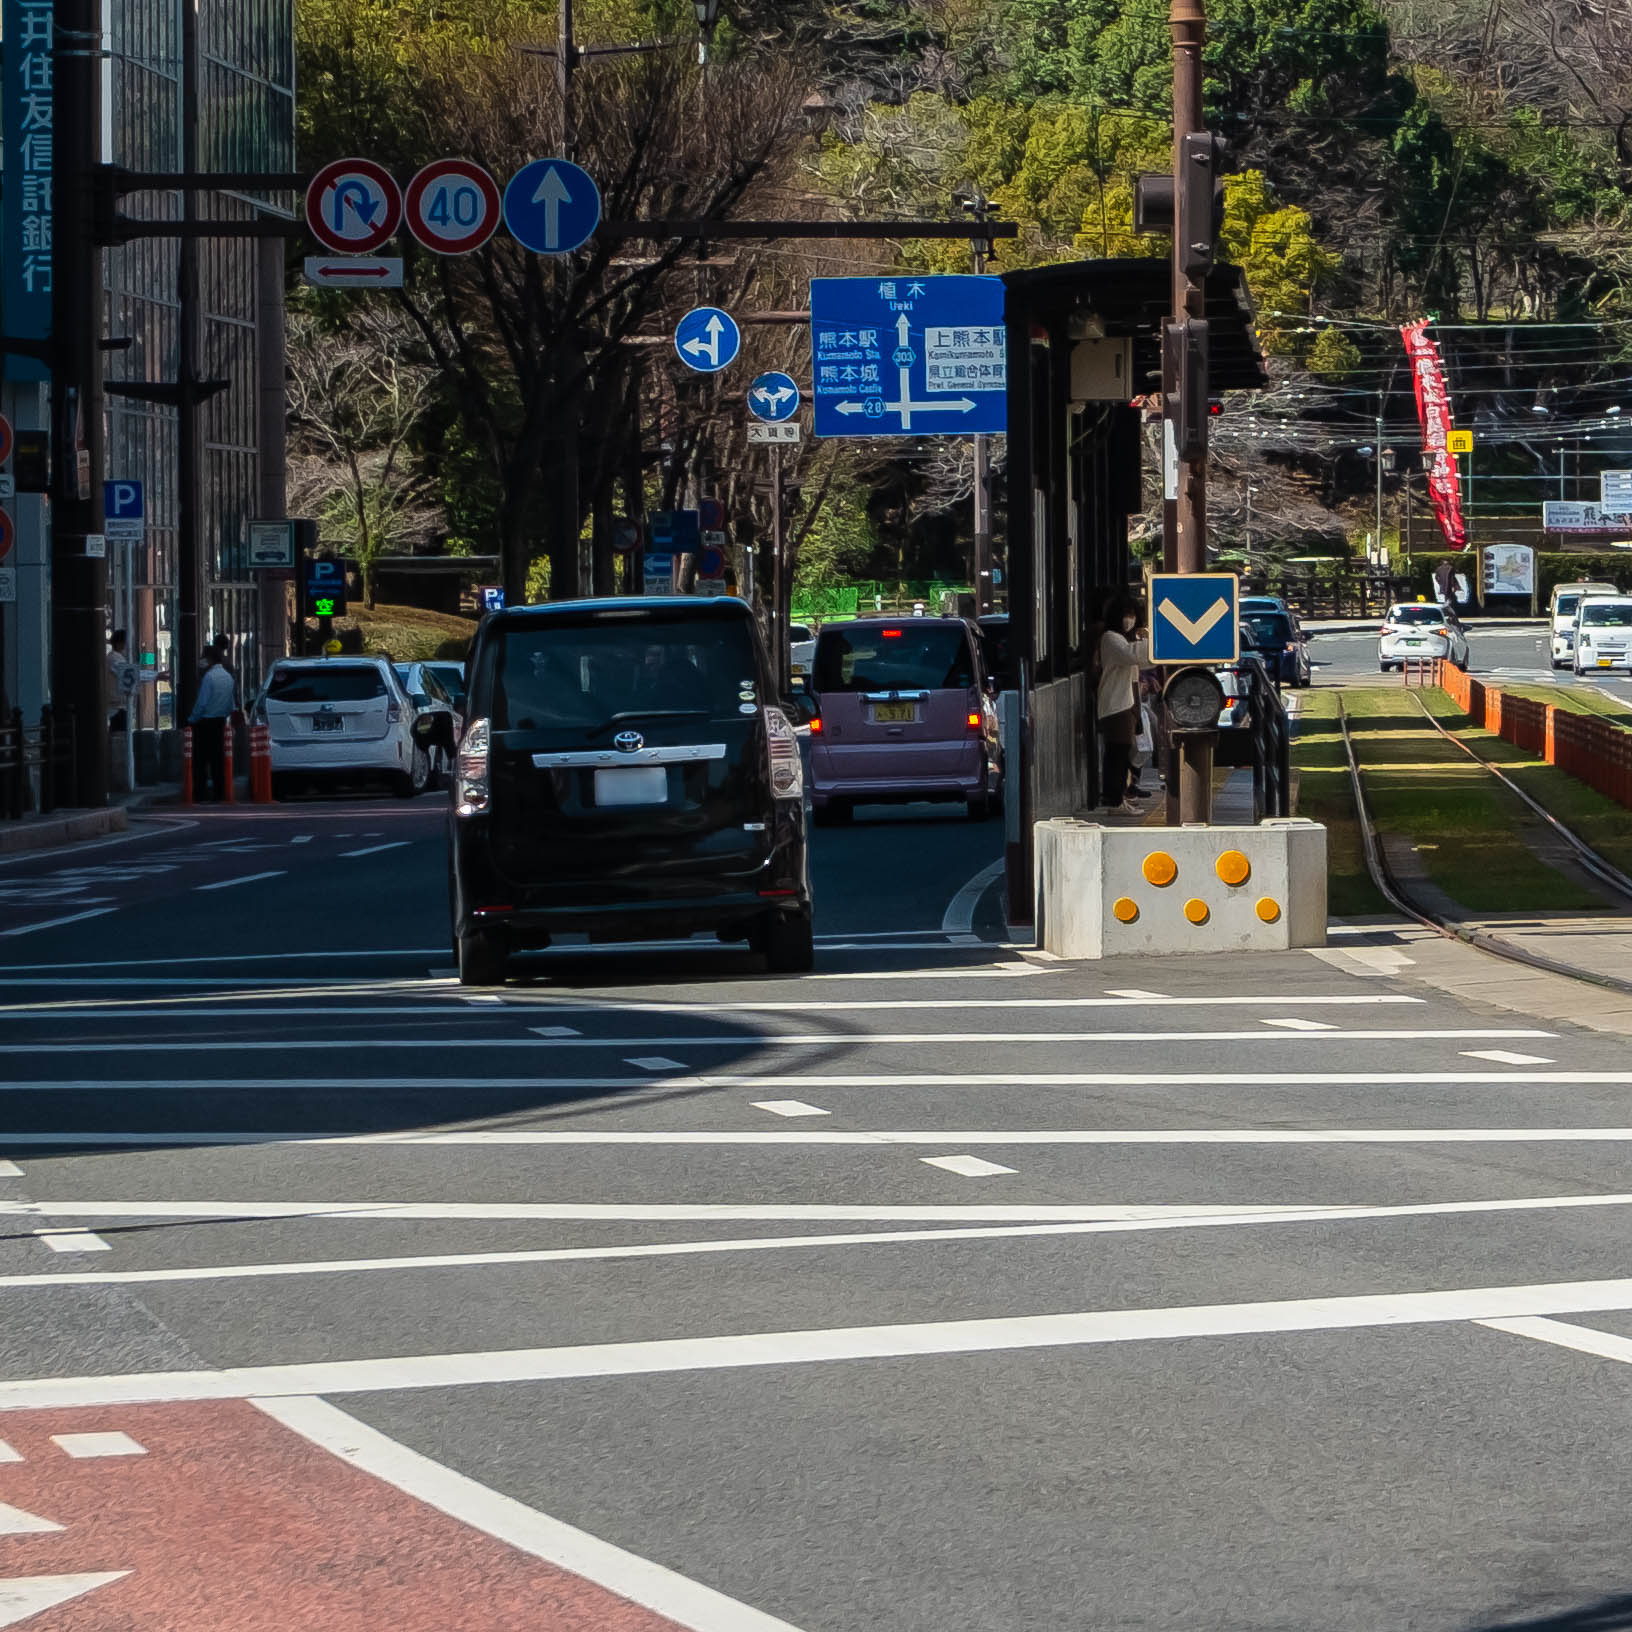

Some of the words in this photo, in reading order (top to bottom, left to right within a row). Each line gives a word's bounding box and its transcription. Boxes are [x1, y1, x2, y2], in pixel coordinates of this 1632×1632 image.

[428, 186, 480, 226] 40
[878, 280, 927, 300] 植木
[889, 300, 914, 312] Ueki
[818, 329, 879, 350] 熊本駅
[819, 364, 880, 384] 熊本城
[114, 484, 136, 515] P
